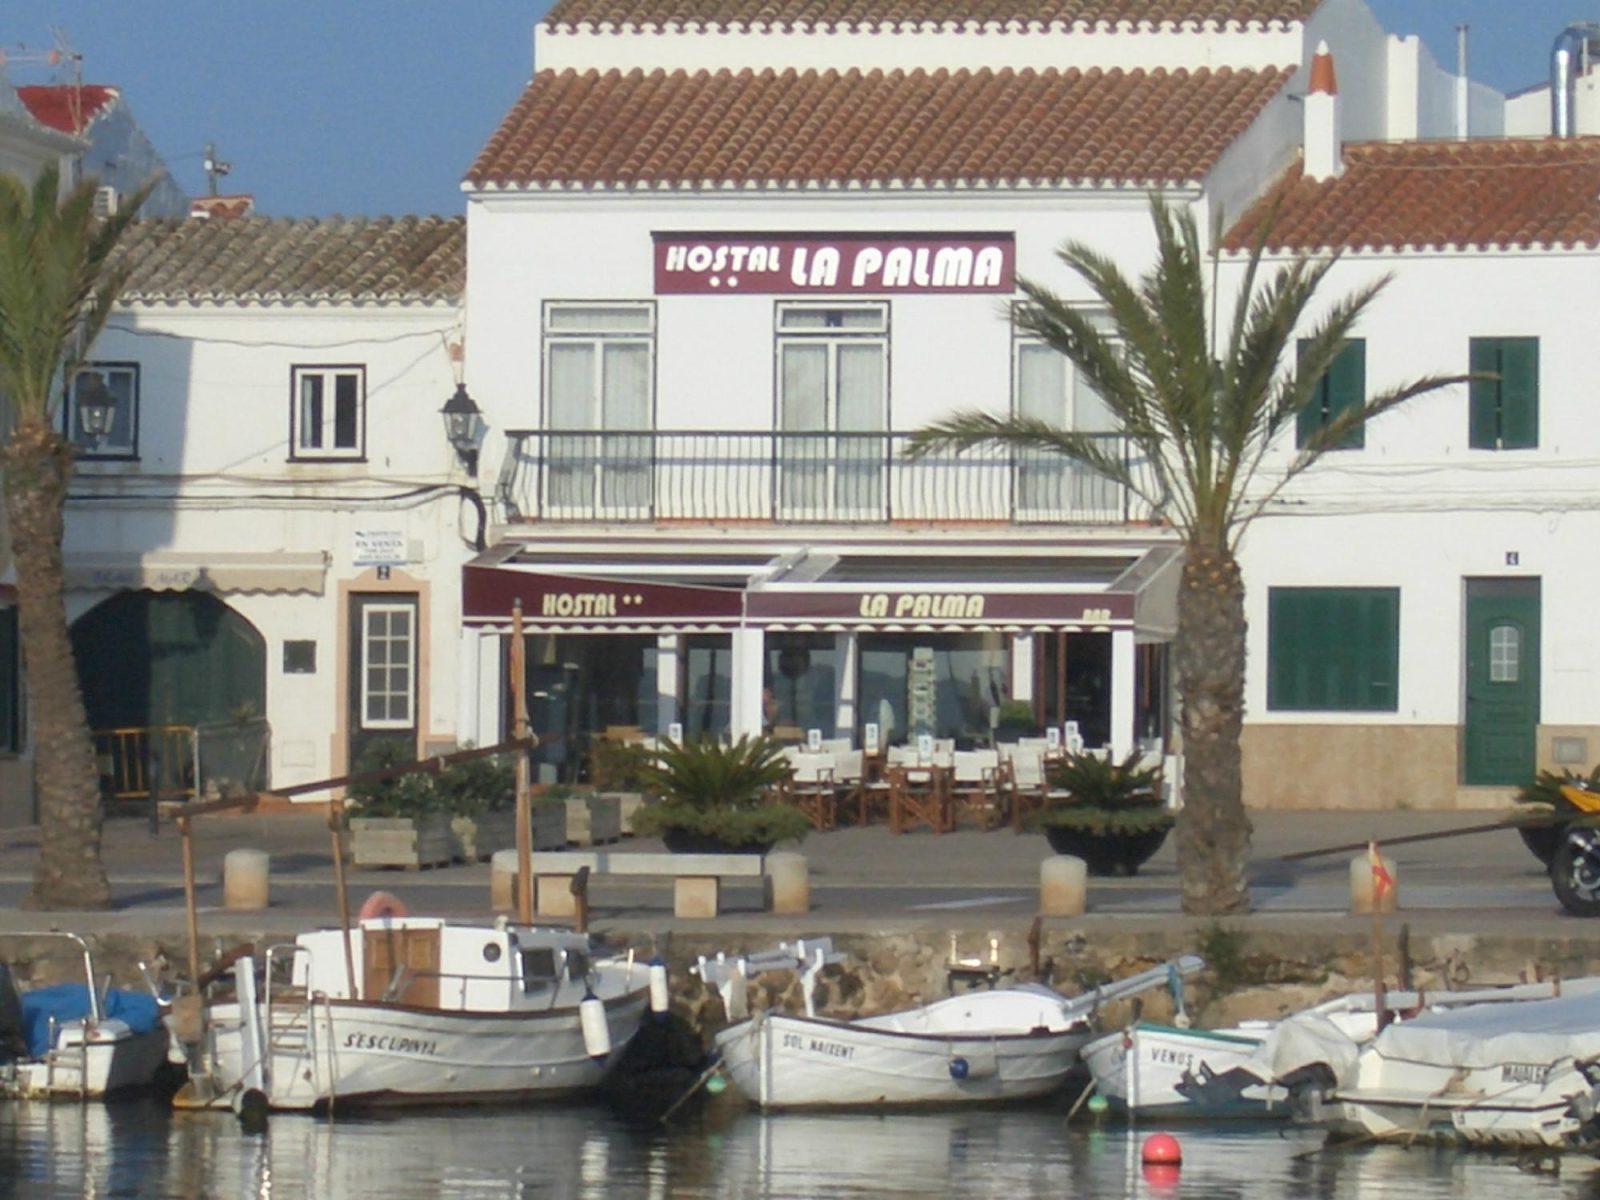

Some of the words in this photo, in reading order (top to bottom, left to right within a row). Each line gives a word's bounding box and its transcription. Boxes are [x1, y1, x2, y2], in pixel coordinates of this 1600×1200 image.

[665, 246, 780, 272] HOSTAL
[791, 247, 840, 287] LA
[852, 247, 1004, 287] PALMA
[542, 593, 617, 617] HOSTAL
[859, 594, 889, 617] LA
[895, 594, 985, 617] PALMA
[1082, 608, 1111, 622] BAR
[783, 1034, 803, 1050] SOL
[1151, 1047, 1194, 1069] VENUS
